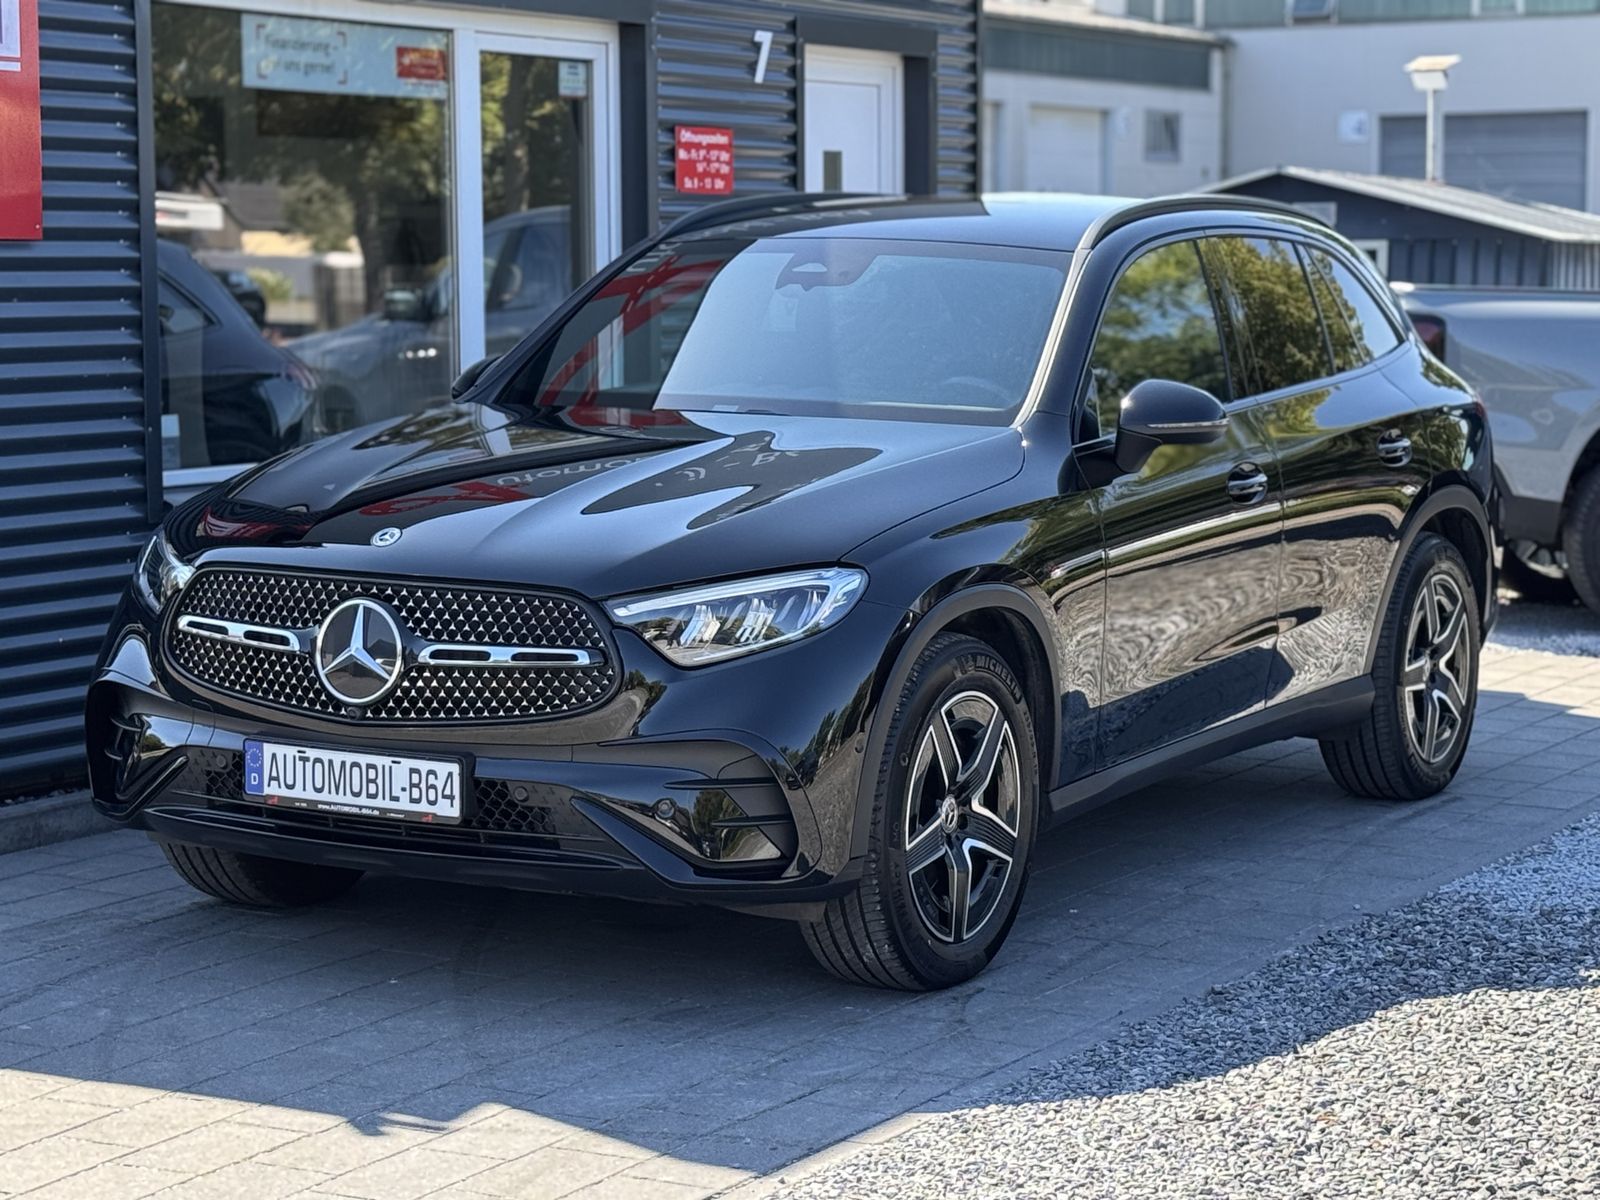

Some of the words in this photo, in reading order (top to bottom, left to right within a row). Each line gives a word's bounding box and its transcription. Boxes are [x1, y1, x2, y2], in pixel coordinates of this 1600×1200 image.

[976, 655, 1021, 700] MICHELIN
[250, 772, 259, 785] D
[267, 752, 456, 808] AUTOMOBIL-B64
